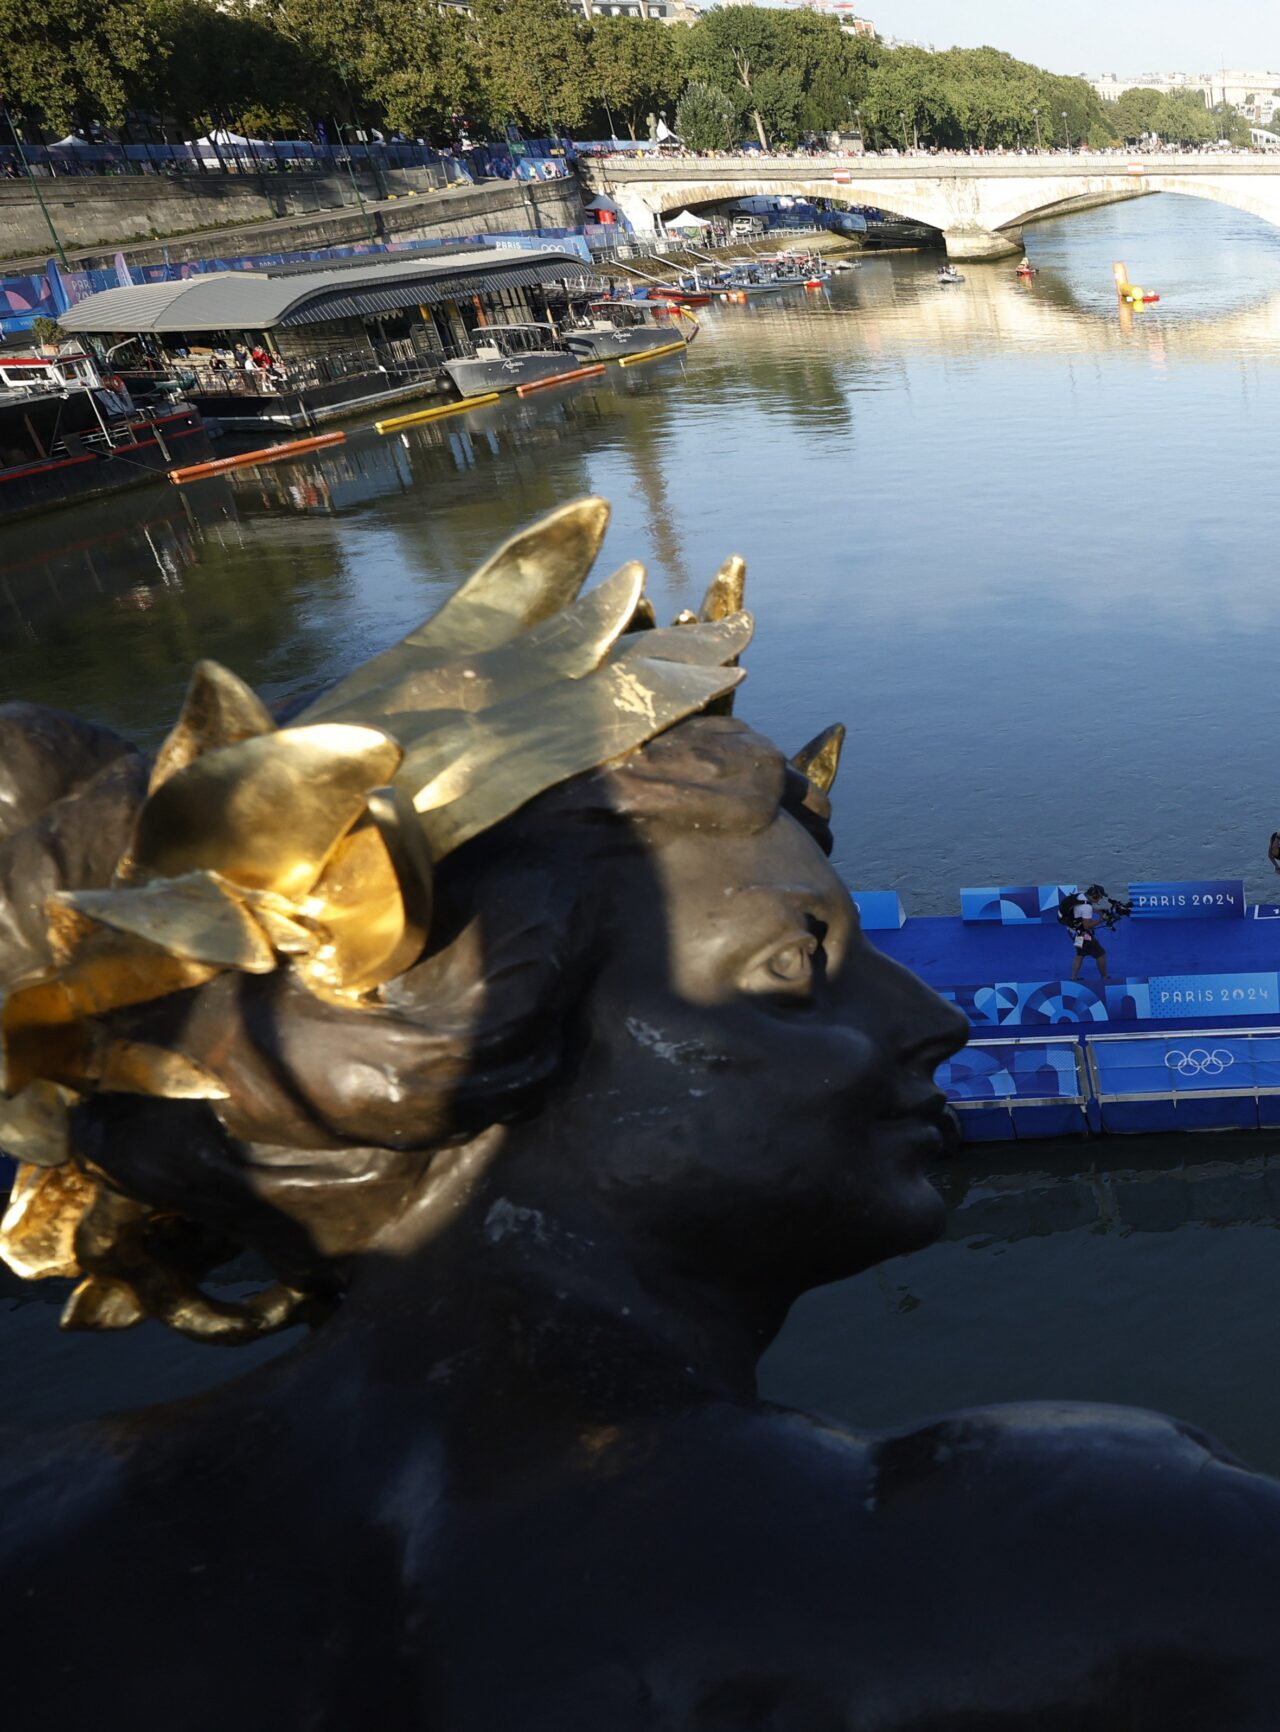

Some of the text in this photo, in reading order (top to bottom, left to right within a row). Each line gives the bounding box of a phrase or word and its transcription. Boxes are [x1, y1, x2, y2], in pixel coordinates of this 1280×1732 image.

[495, 240, 521, 251] PARIS
[1139, 893, 1234, 907] PARIS 2024
[1161, 988, 1268, 1003] PARIS 2024
